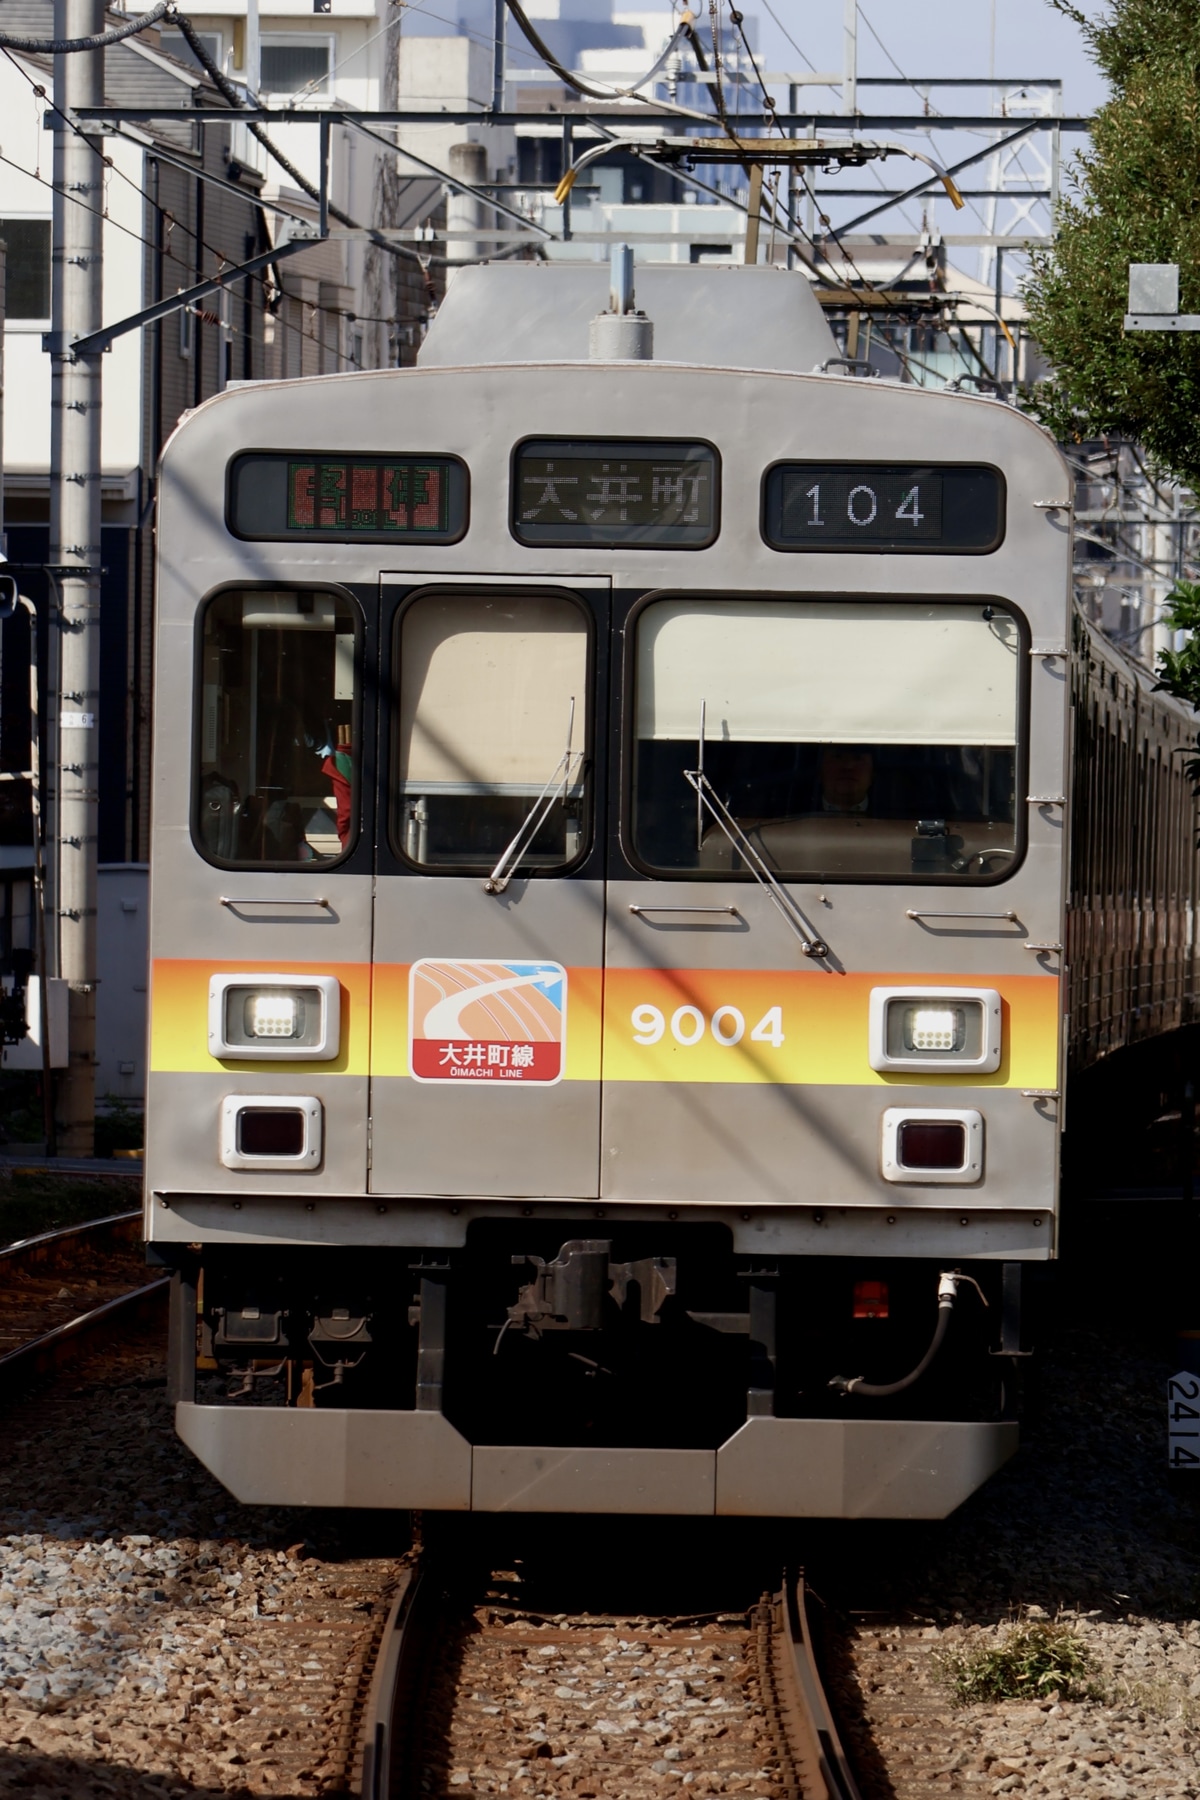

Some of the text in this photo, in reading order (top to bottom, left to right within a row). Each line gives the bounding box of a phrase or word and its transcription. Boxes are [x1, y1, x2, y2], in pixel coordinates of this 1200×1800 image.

[523, 463, 708, 522] 大井町
[806, 485, 924, 527] 104
[631, 1003, 785, 1048] 9004
[438, 1043, 535, 1068] 大井町線
[499, 1069, 523, 1078] LINE
[1168, 1380, 1200, 1467] 2414
